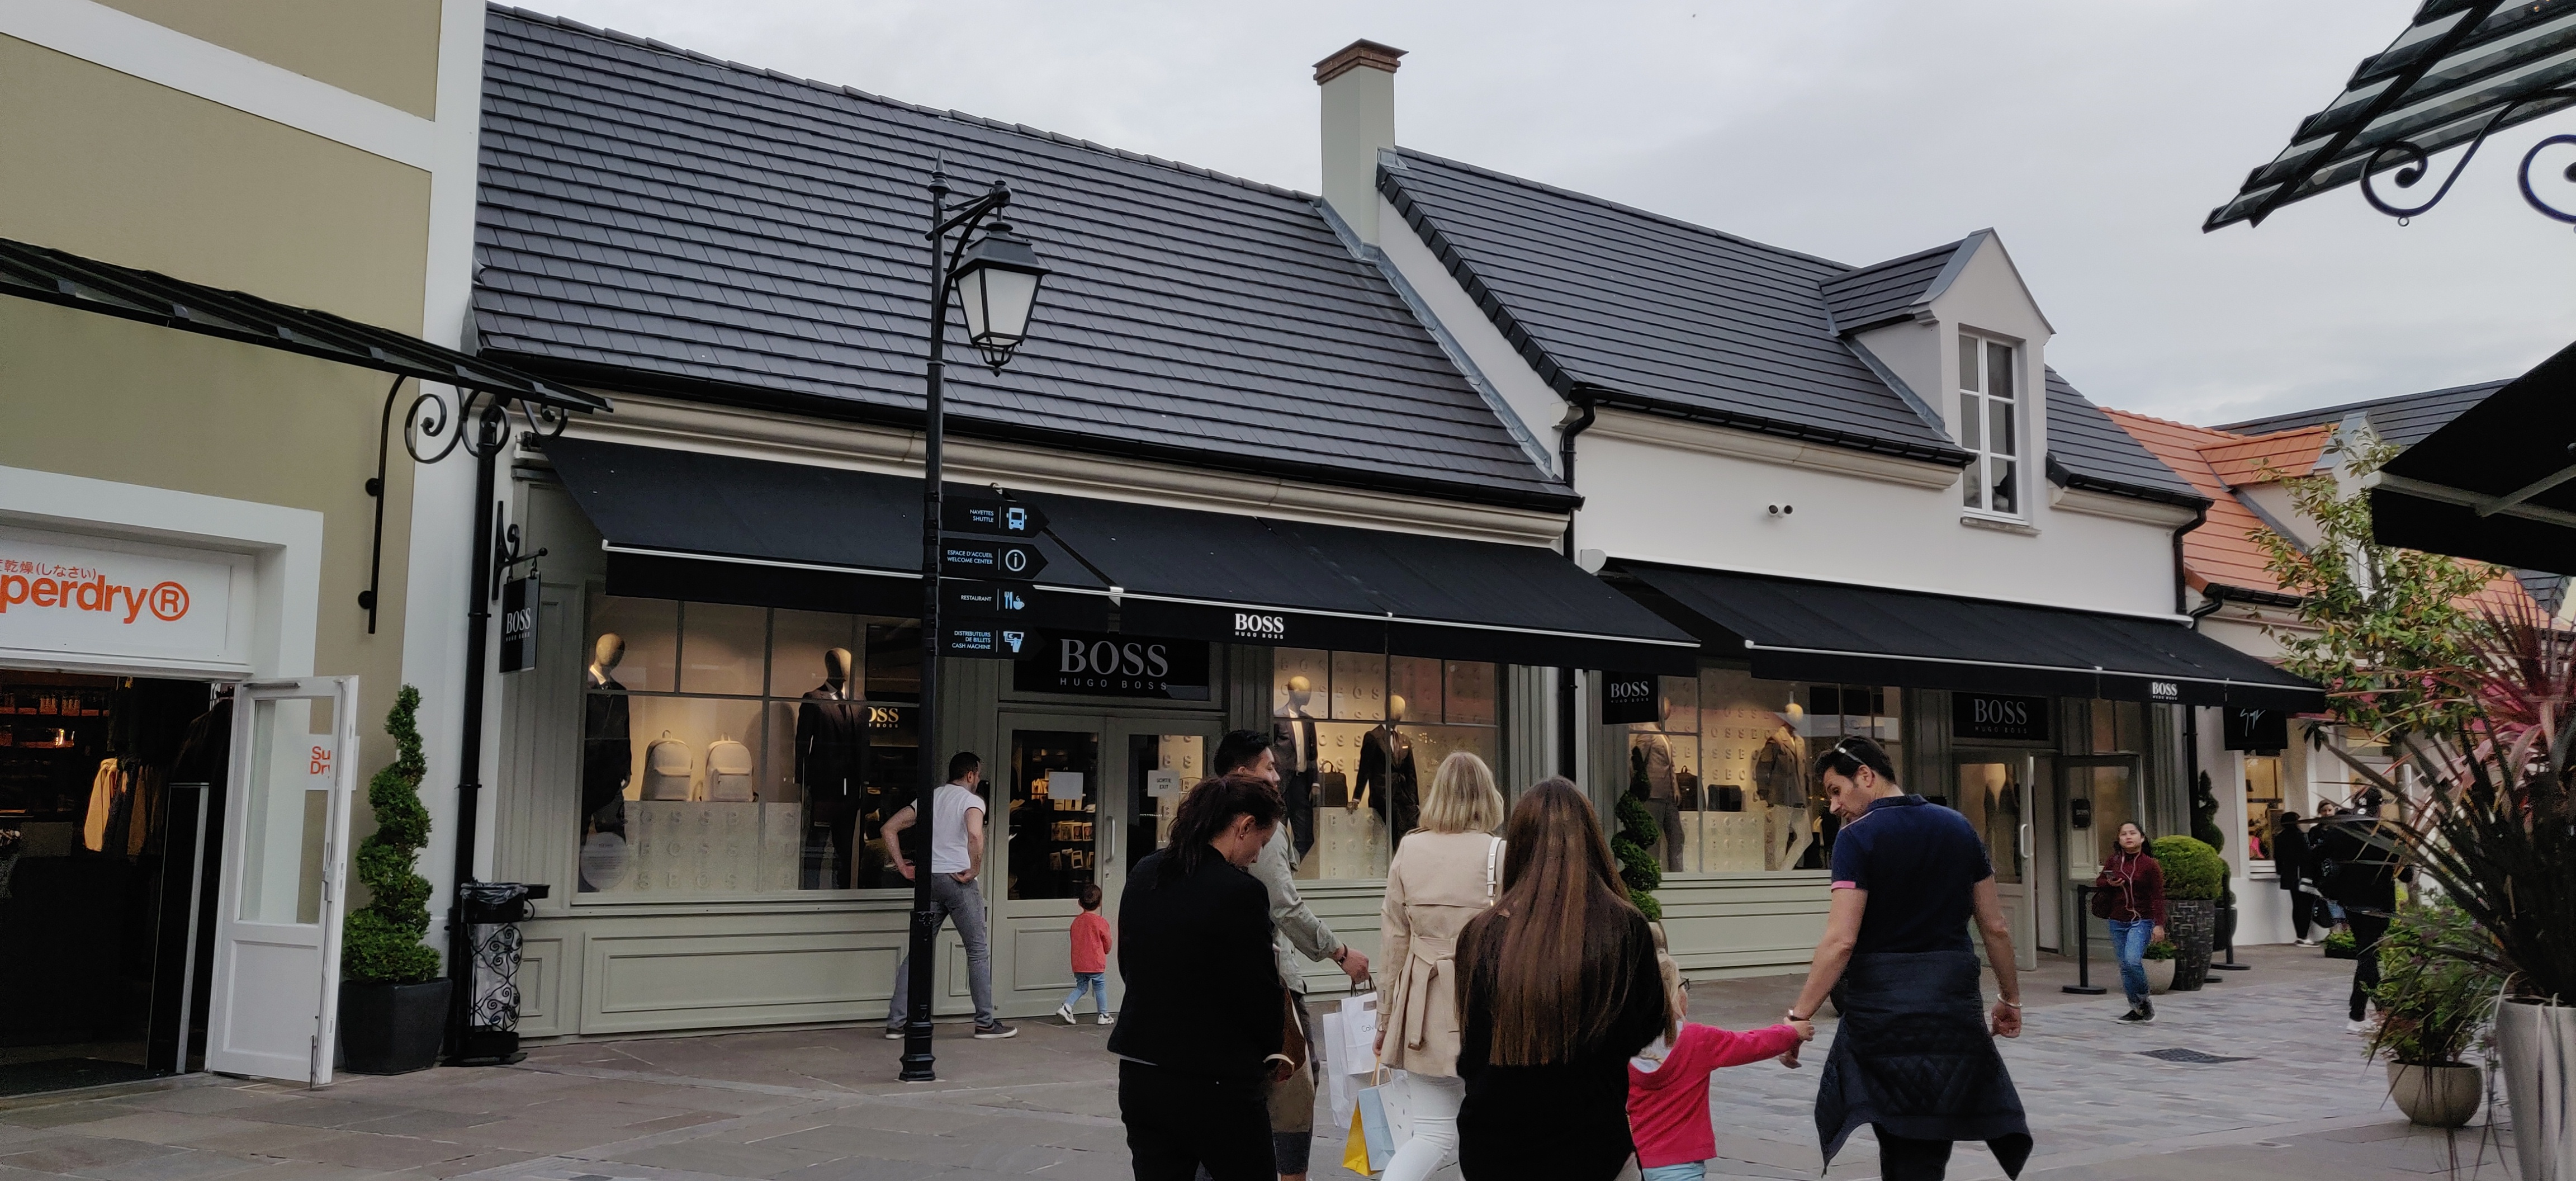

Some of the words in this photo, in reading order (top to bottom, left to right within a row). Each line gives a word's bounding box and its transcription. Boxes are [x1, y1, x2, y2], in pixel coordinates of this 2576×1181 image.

[506, 607, 531, 634] BOSS
[1235, 613, 1284, 633] BOSS
[1059, 639, 1168, 677] BOSS
[1060, 678, 1107, 687] HUGO
[1121, 681, 1167, 690] BOSS
[1611, 681, 1649, 698] BOSS
[2152, 682, 2178, 696] BOSS
[1974, 698, 2027, 725] BOSS
